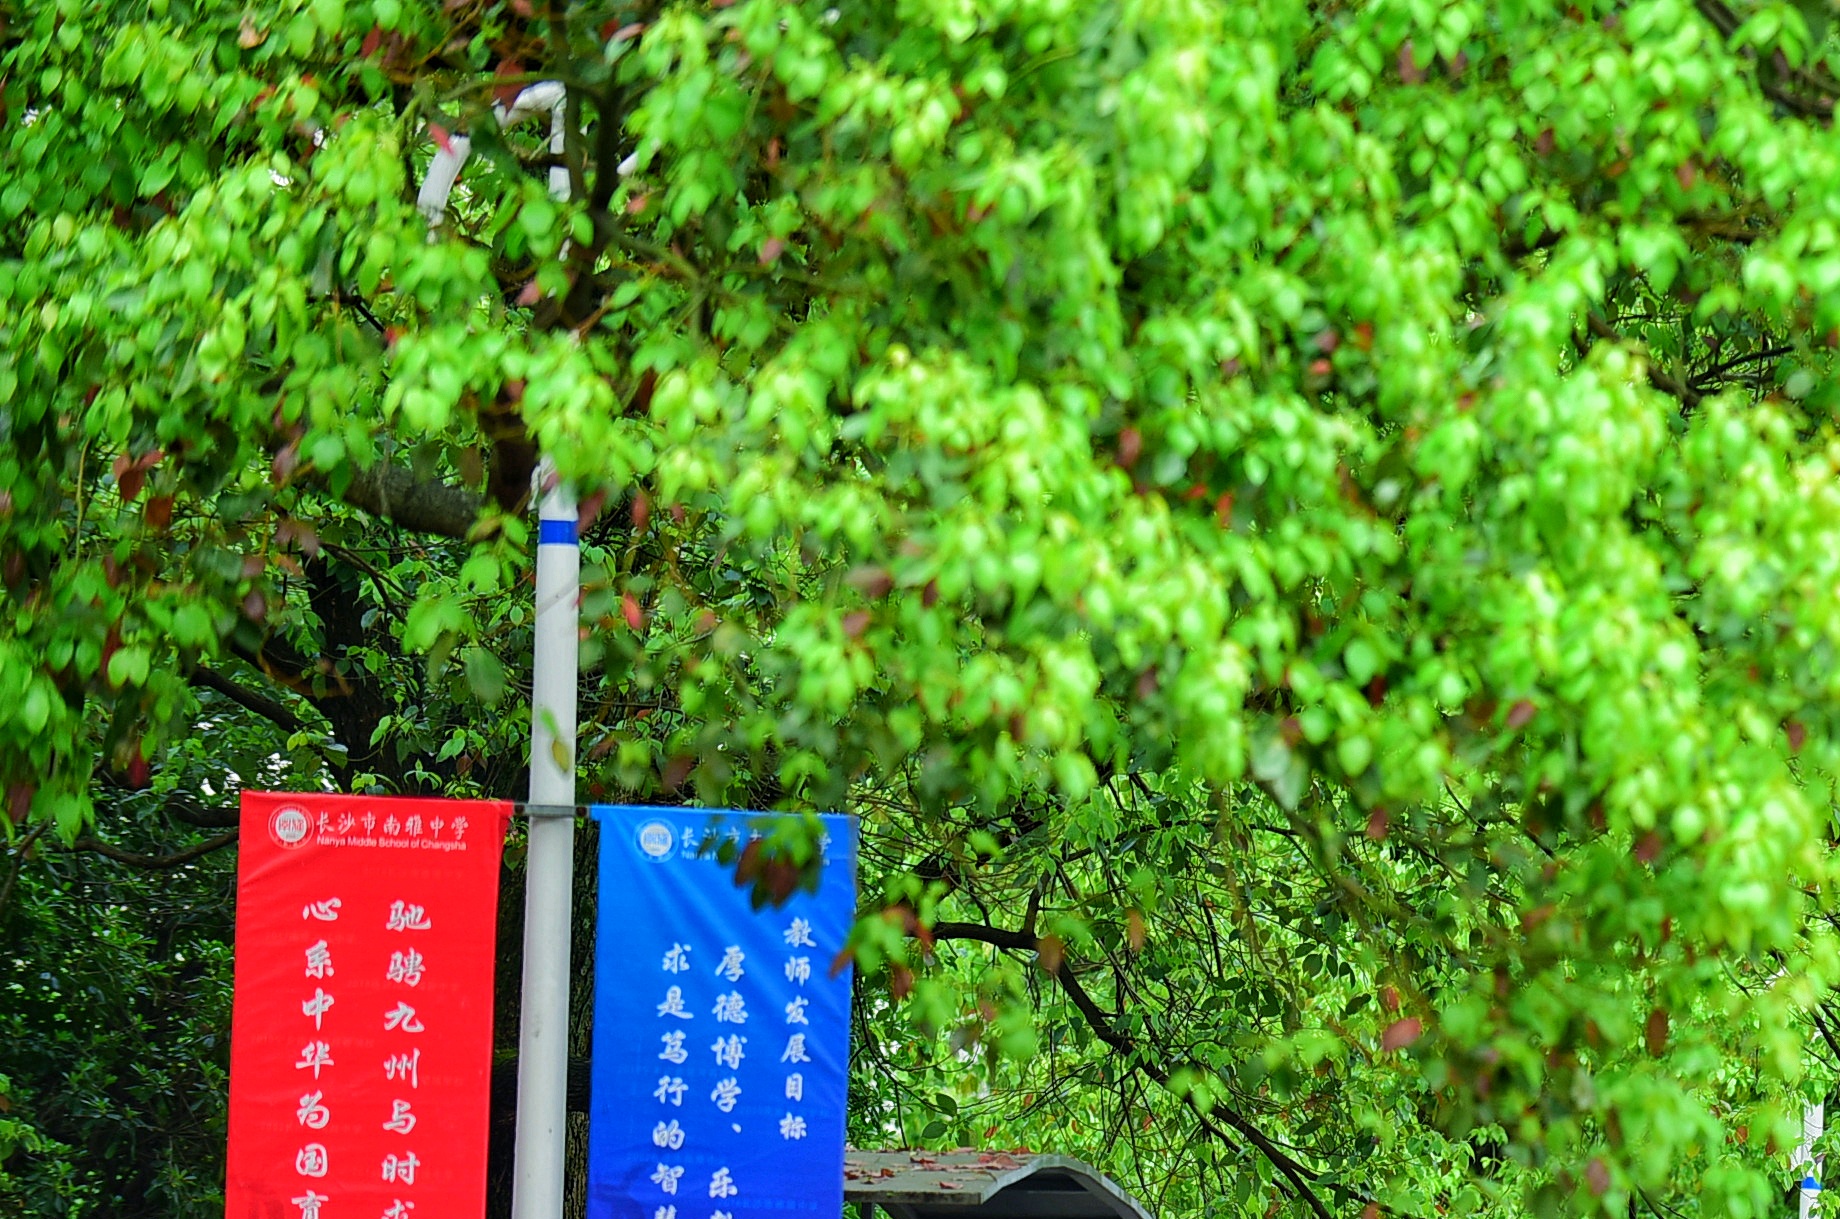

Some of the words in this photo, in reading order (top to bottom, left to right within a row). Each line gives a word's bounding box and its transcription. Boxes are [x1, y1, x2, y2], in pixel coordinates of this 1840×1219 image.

[316, 811, 469, 840] 长沙市南雅中学
[316, 835, 346, 848] Nanya
[347, 836, 377, 848] Middle
[378, 837, 409, 848] School
[411, 838, 420, 848] of
[421, 839, 466, 852] Changsha
[779, 917, 818, 1140] 教师发展目标
